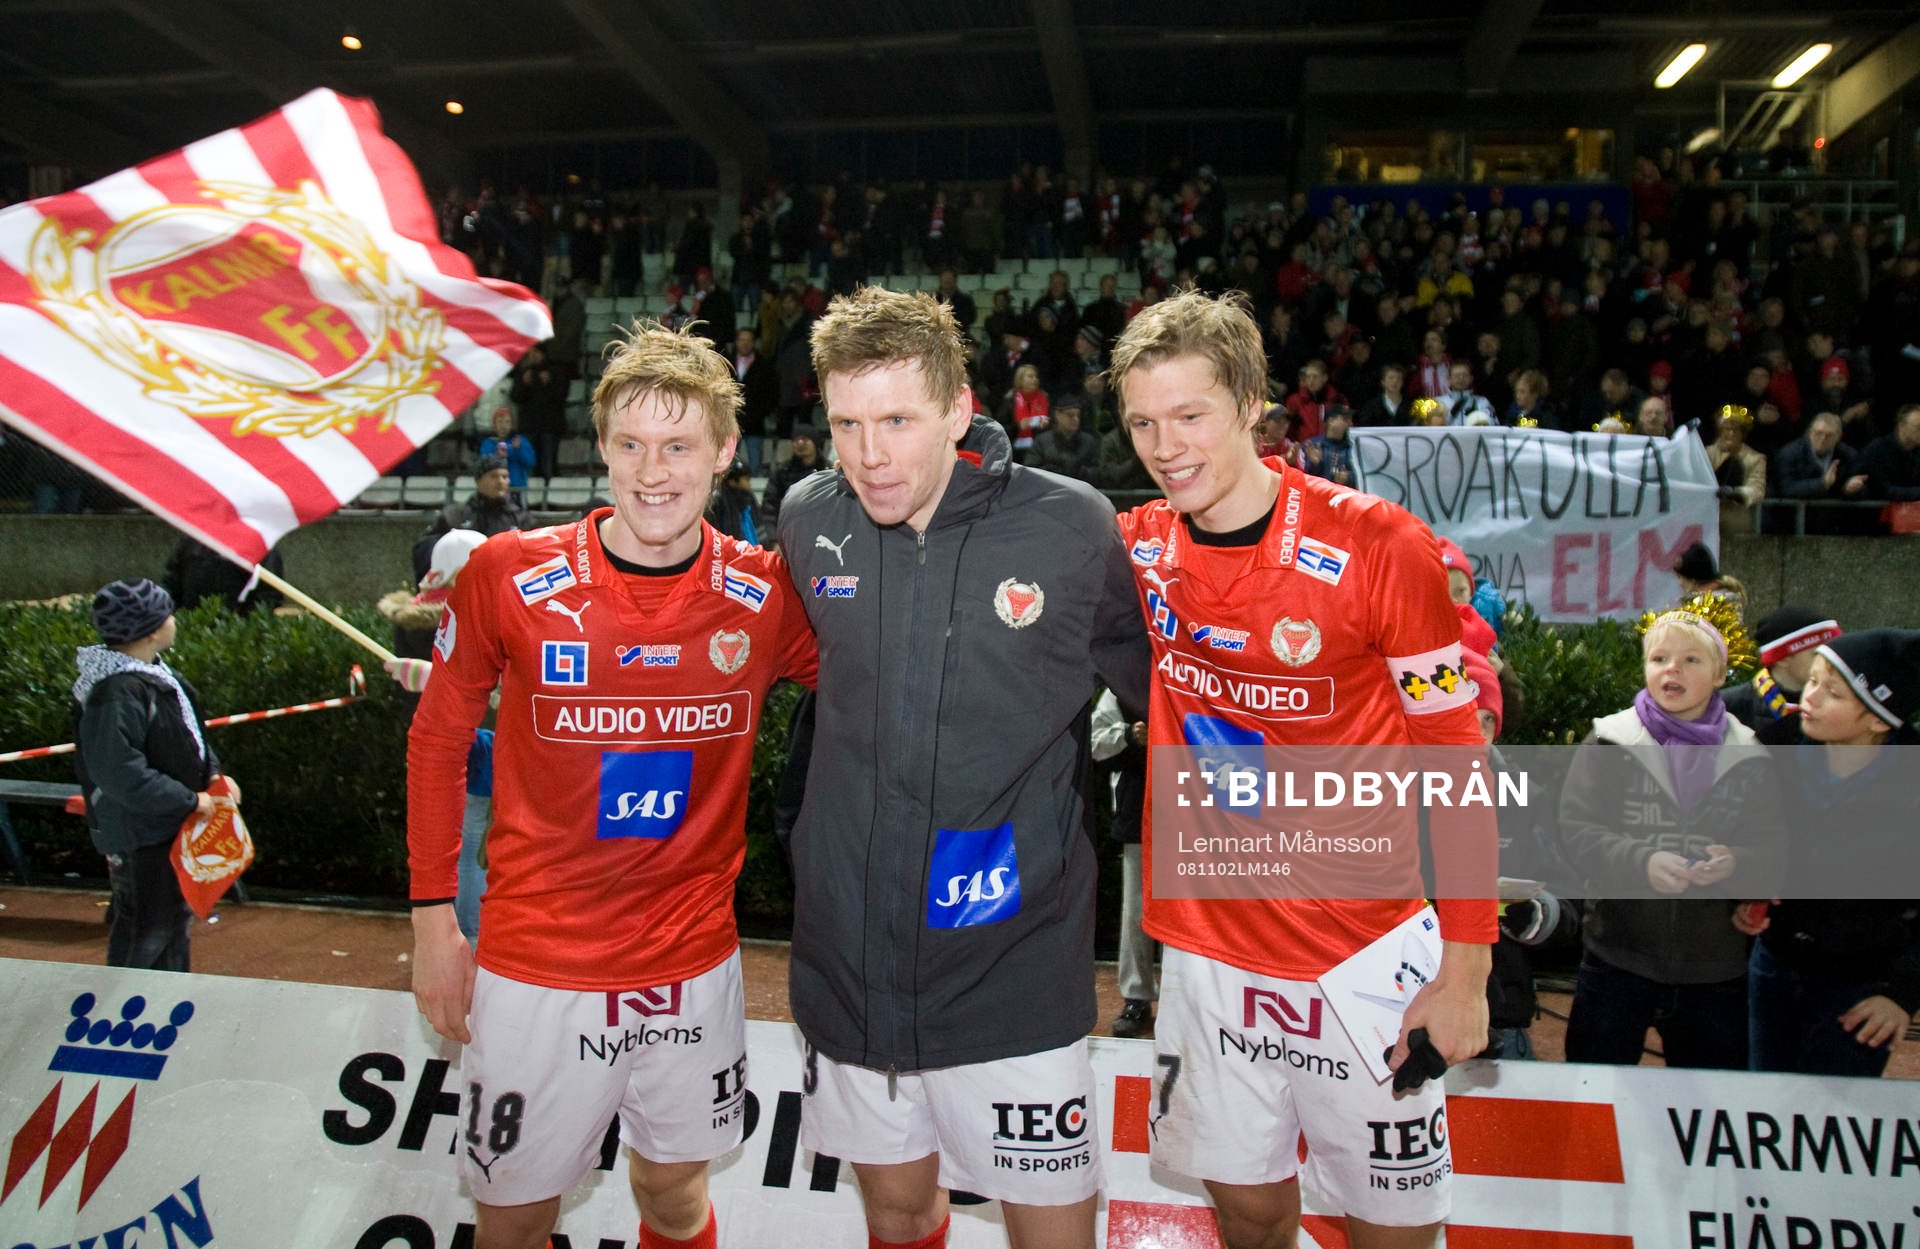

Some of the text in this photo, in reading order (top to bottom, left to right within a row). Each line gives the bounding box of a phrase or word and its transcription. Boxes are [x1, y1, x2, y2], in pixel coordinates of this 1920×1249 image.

[118, 232, 299, 314] KALMAR
[259, 303, 358, 360] FF
[1353, 432, 1671, 524] BROAKULLA
[1280, 487, 1301, 565] AUDIO VIDEO
[577, 548, 593, 585] AUDIO
[711, 560, 723, 591] VIDEO
[828, 587, 856, 598] SPORT
[642, 645, 679, 656] INTER
[643, 655, 679, 666] SPORT
[1211, 638, 1246, 651] SPORT
[1158, 652, 1310, 711] AUDIO VIDEO
[554, 702, 732, 734] AUDIO VIDEO
[606, 790, 683, 821] SAS
[192, 810, 230, 854] KALMAR
[213, 835, 239, 855] FF
[935, 866, 1010, 907] SAS
[579, 1023, 703, 1067] Nybloms
[1219, 1027, 1350, 1080] Nybloms
[1157, 1053, 1181, 1116] 7
[465, 1081, 526, 1154] 18
[991, 1094, 1088, 1142] IEC
[1367, 1105, 1446, 1161] IEC
[994, 1150, 1090, 1173] IN SPORTS
[1667, 1107, 1920, 1177] VARMVA
[1370, 1174, 1389, 1190] IN
